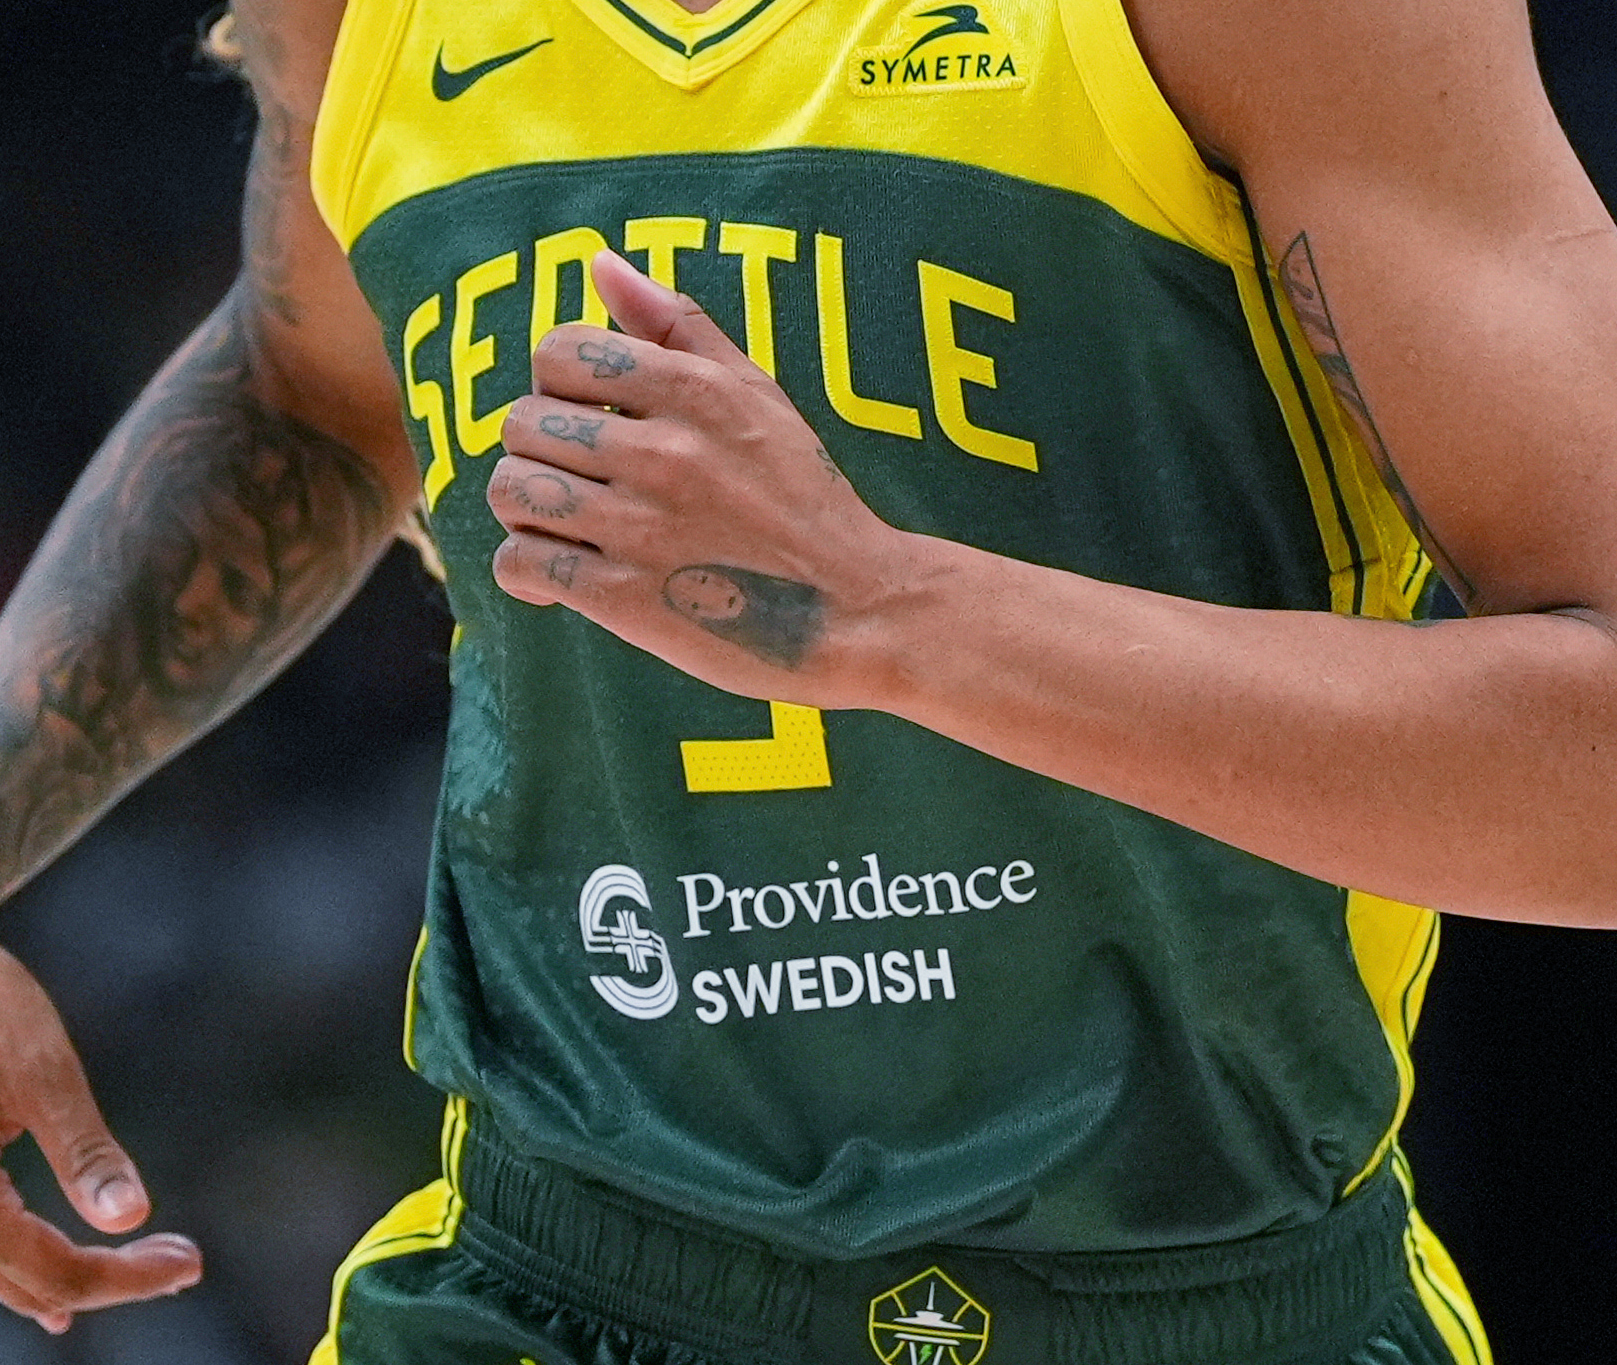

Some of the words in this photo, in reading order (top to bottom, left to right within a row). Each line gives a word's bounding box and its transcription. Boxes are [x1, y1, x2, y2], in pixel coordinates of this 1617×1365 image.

[859, 52, 1017, 86] SYMETRA
[675, 852, 1038, 939] Providence
[691, 947, 957, 1025] SWEDISH
